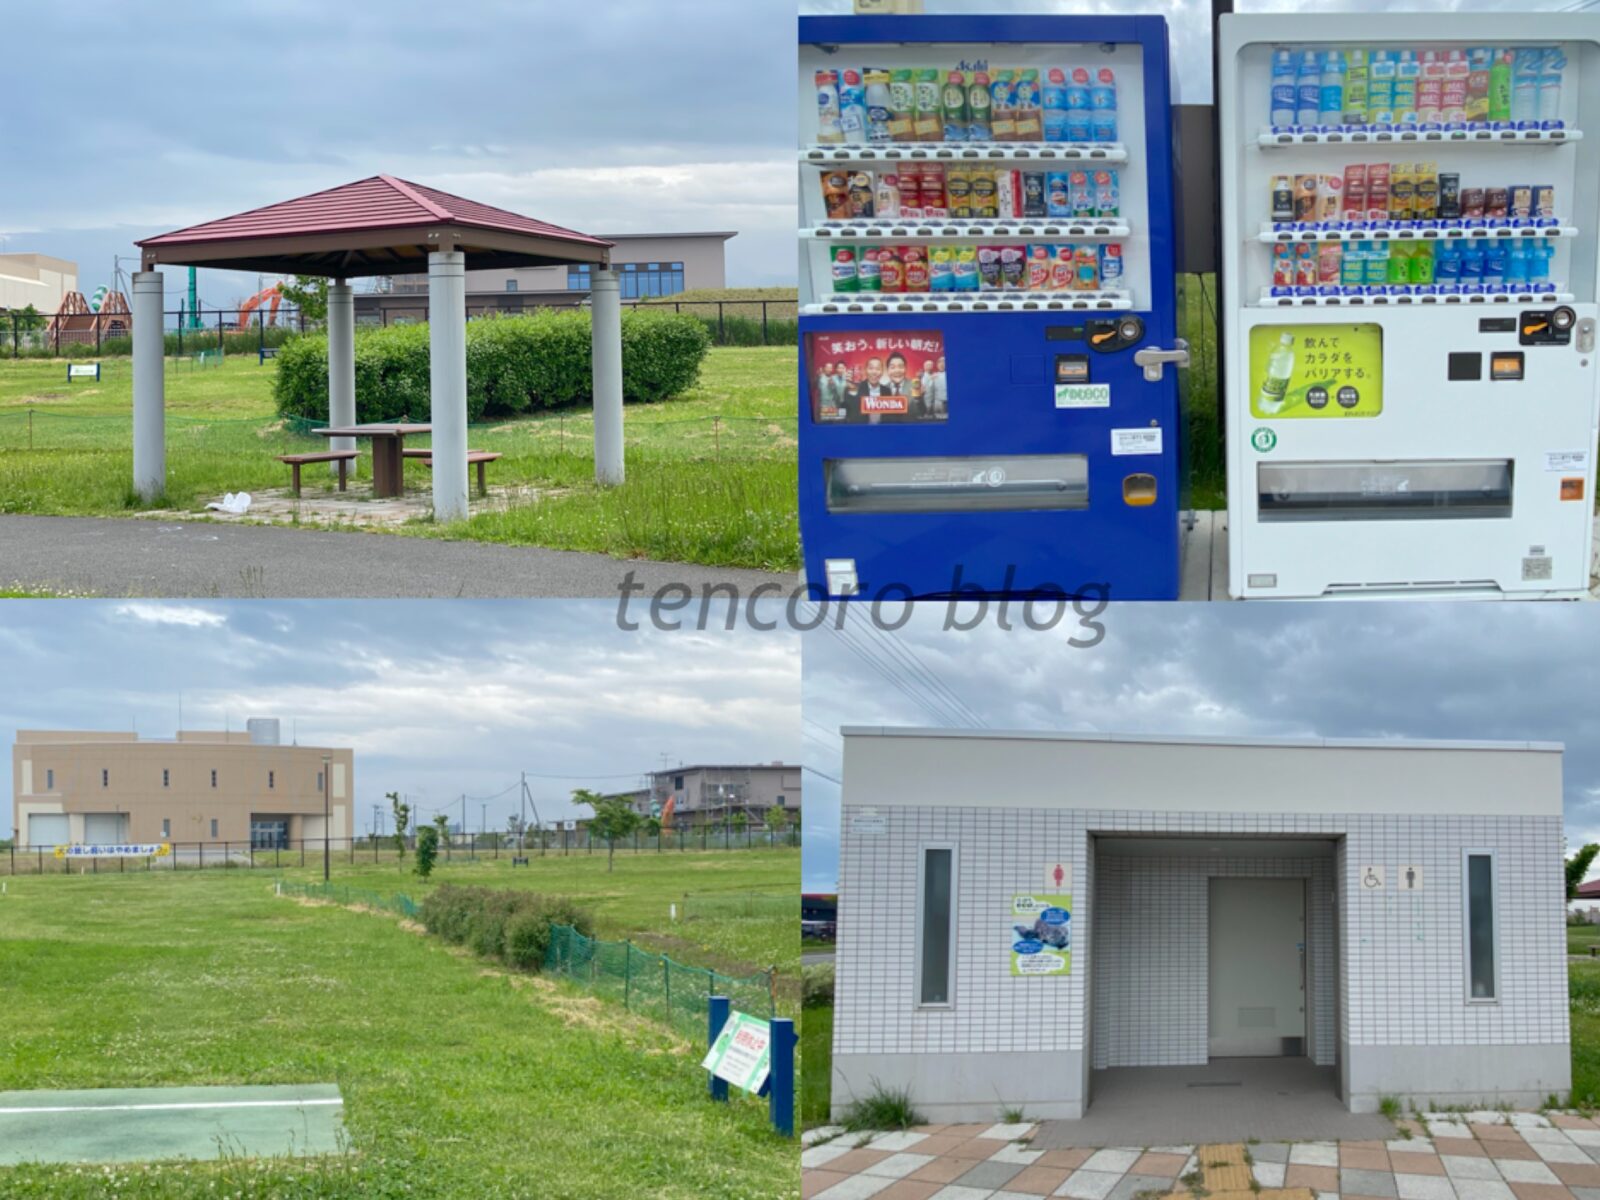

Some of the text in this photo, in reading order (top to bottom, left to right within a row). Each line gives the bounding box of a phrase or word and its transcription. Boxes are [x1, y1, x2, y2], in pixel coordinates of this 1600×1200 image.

[1304, 352, 1352, 365] カラダを
[864, 397, 903, 409] WONDA
